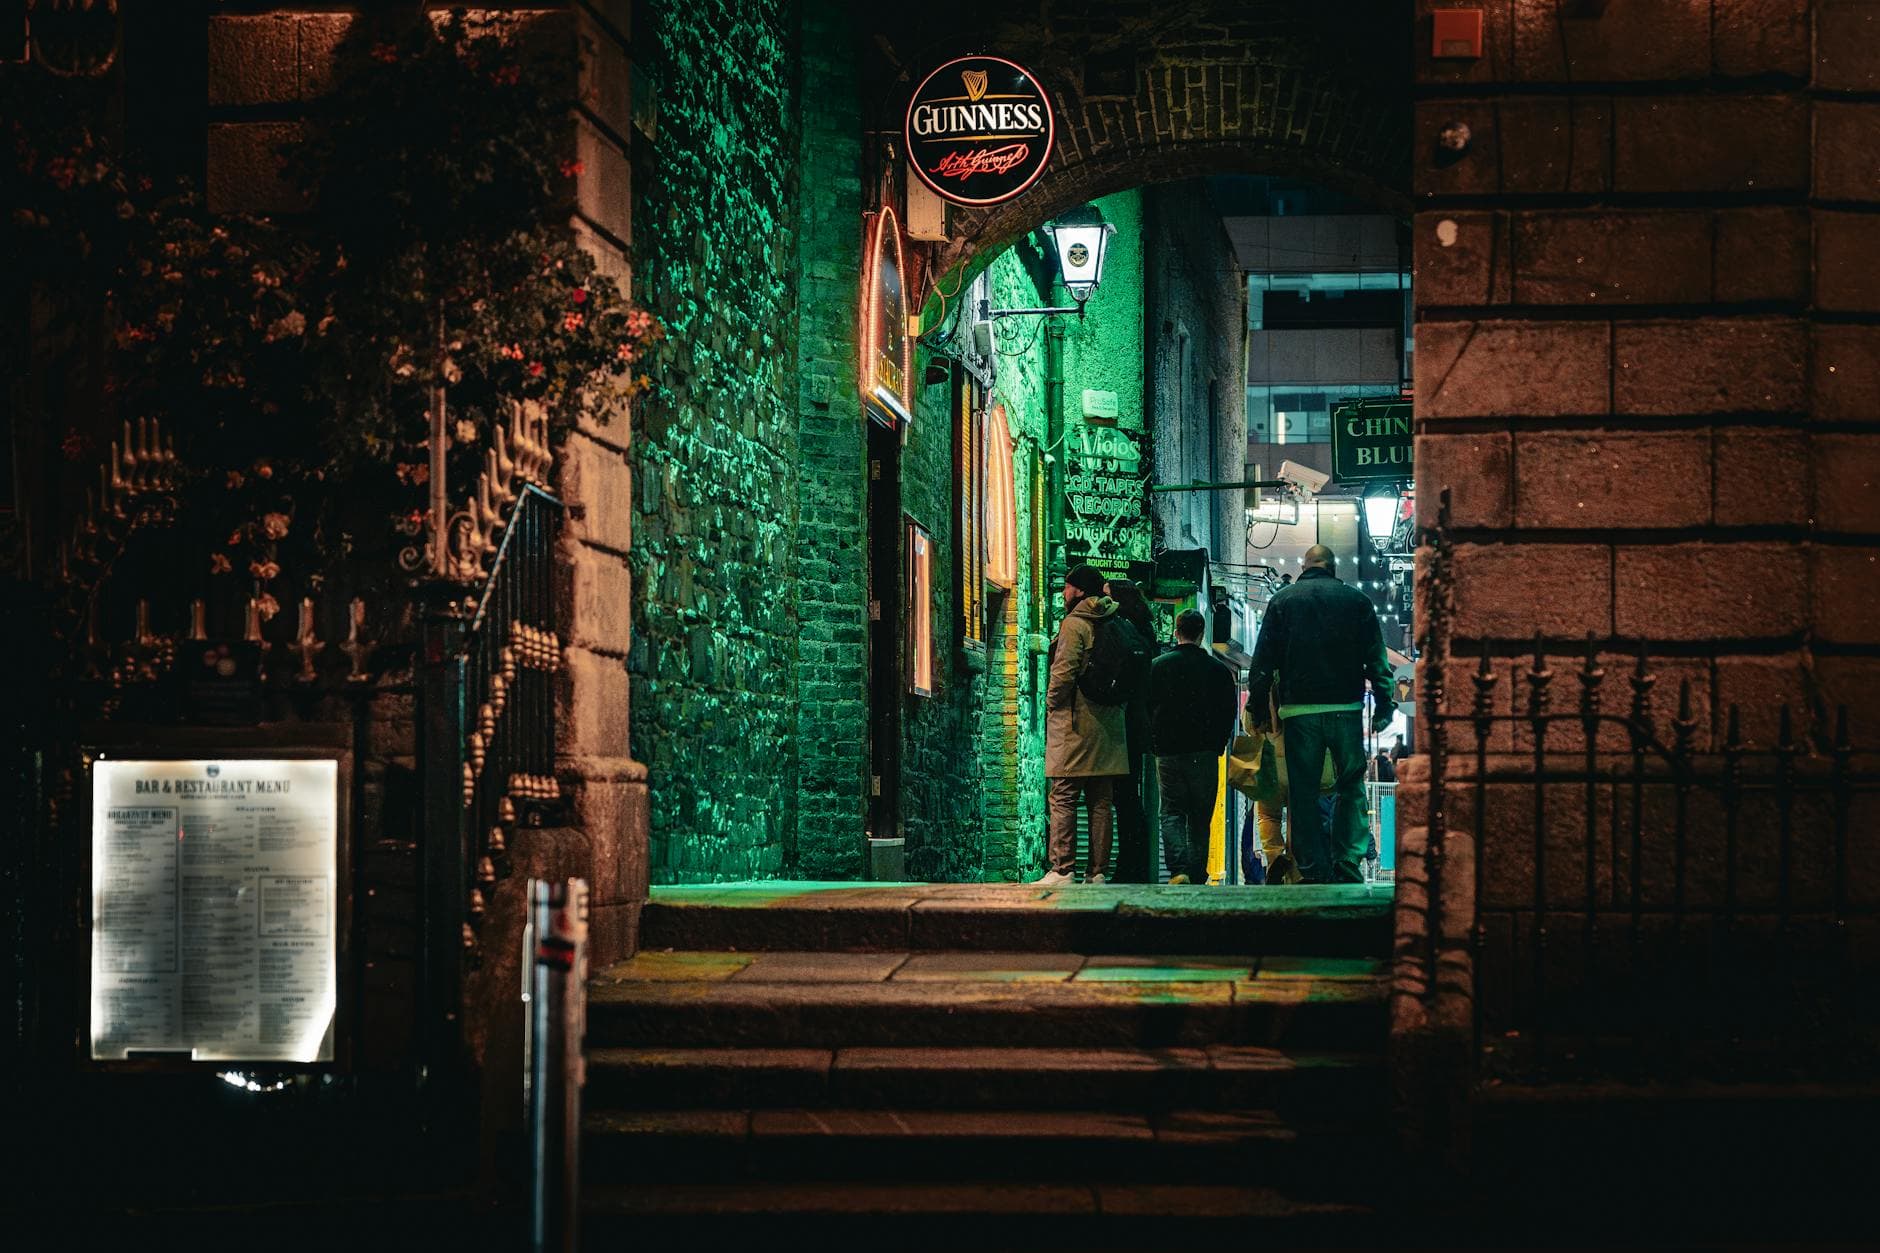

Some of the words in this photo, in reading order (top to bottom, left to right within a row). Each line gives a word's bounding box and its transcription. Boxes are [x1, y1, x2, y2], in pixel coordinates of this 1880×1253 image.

[913, 103, 1043, 135] GUINNESS
[1347, 417, 1414, 437] CHIN
[1096, 477, 1144, 497] TAPES
[1073, 495, 1142, 517] RECORDS
[1119, 528, 1144, 544] SO
[1086, 558, 1113, 568] BOUGHT
[1113, 560, 1130, 569] SOLD
[135, 779, 159, 794] BAR
[162, 779, 172, 794] &
[175, 779, 252, 794] RESTAURANT
[255, 779, 291, 793] MENU
